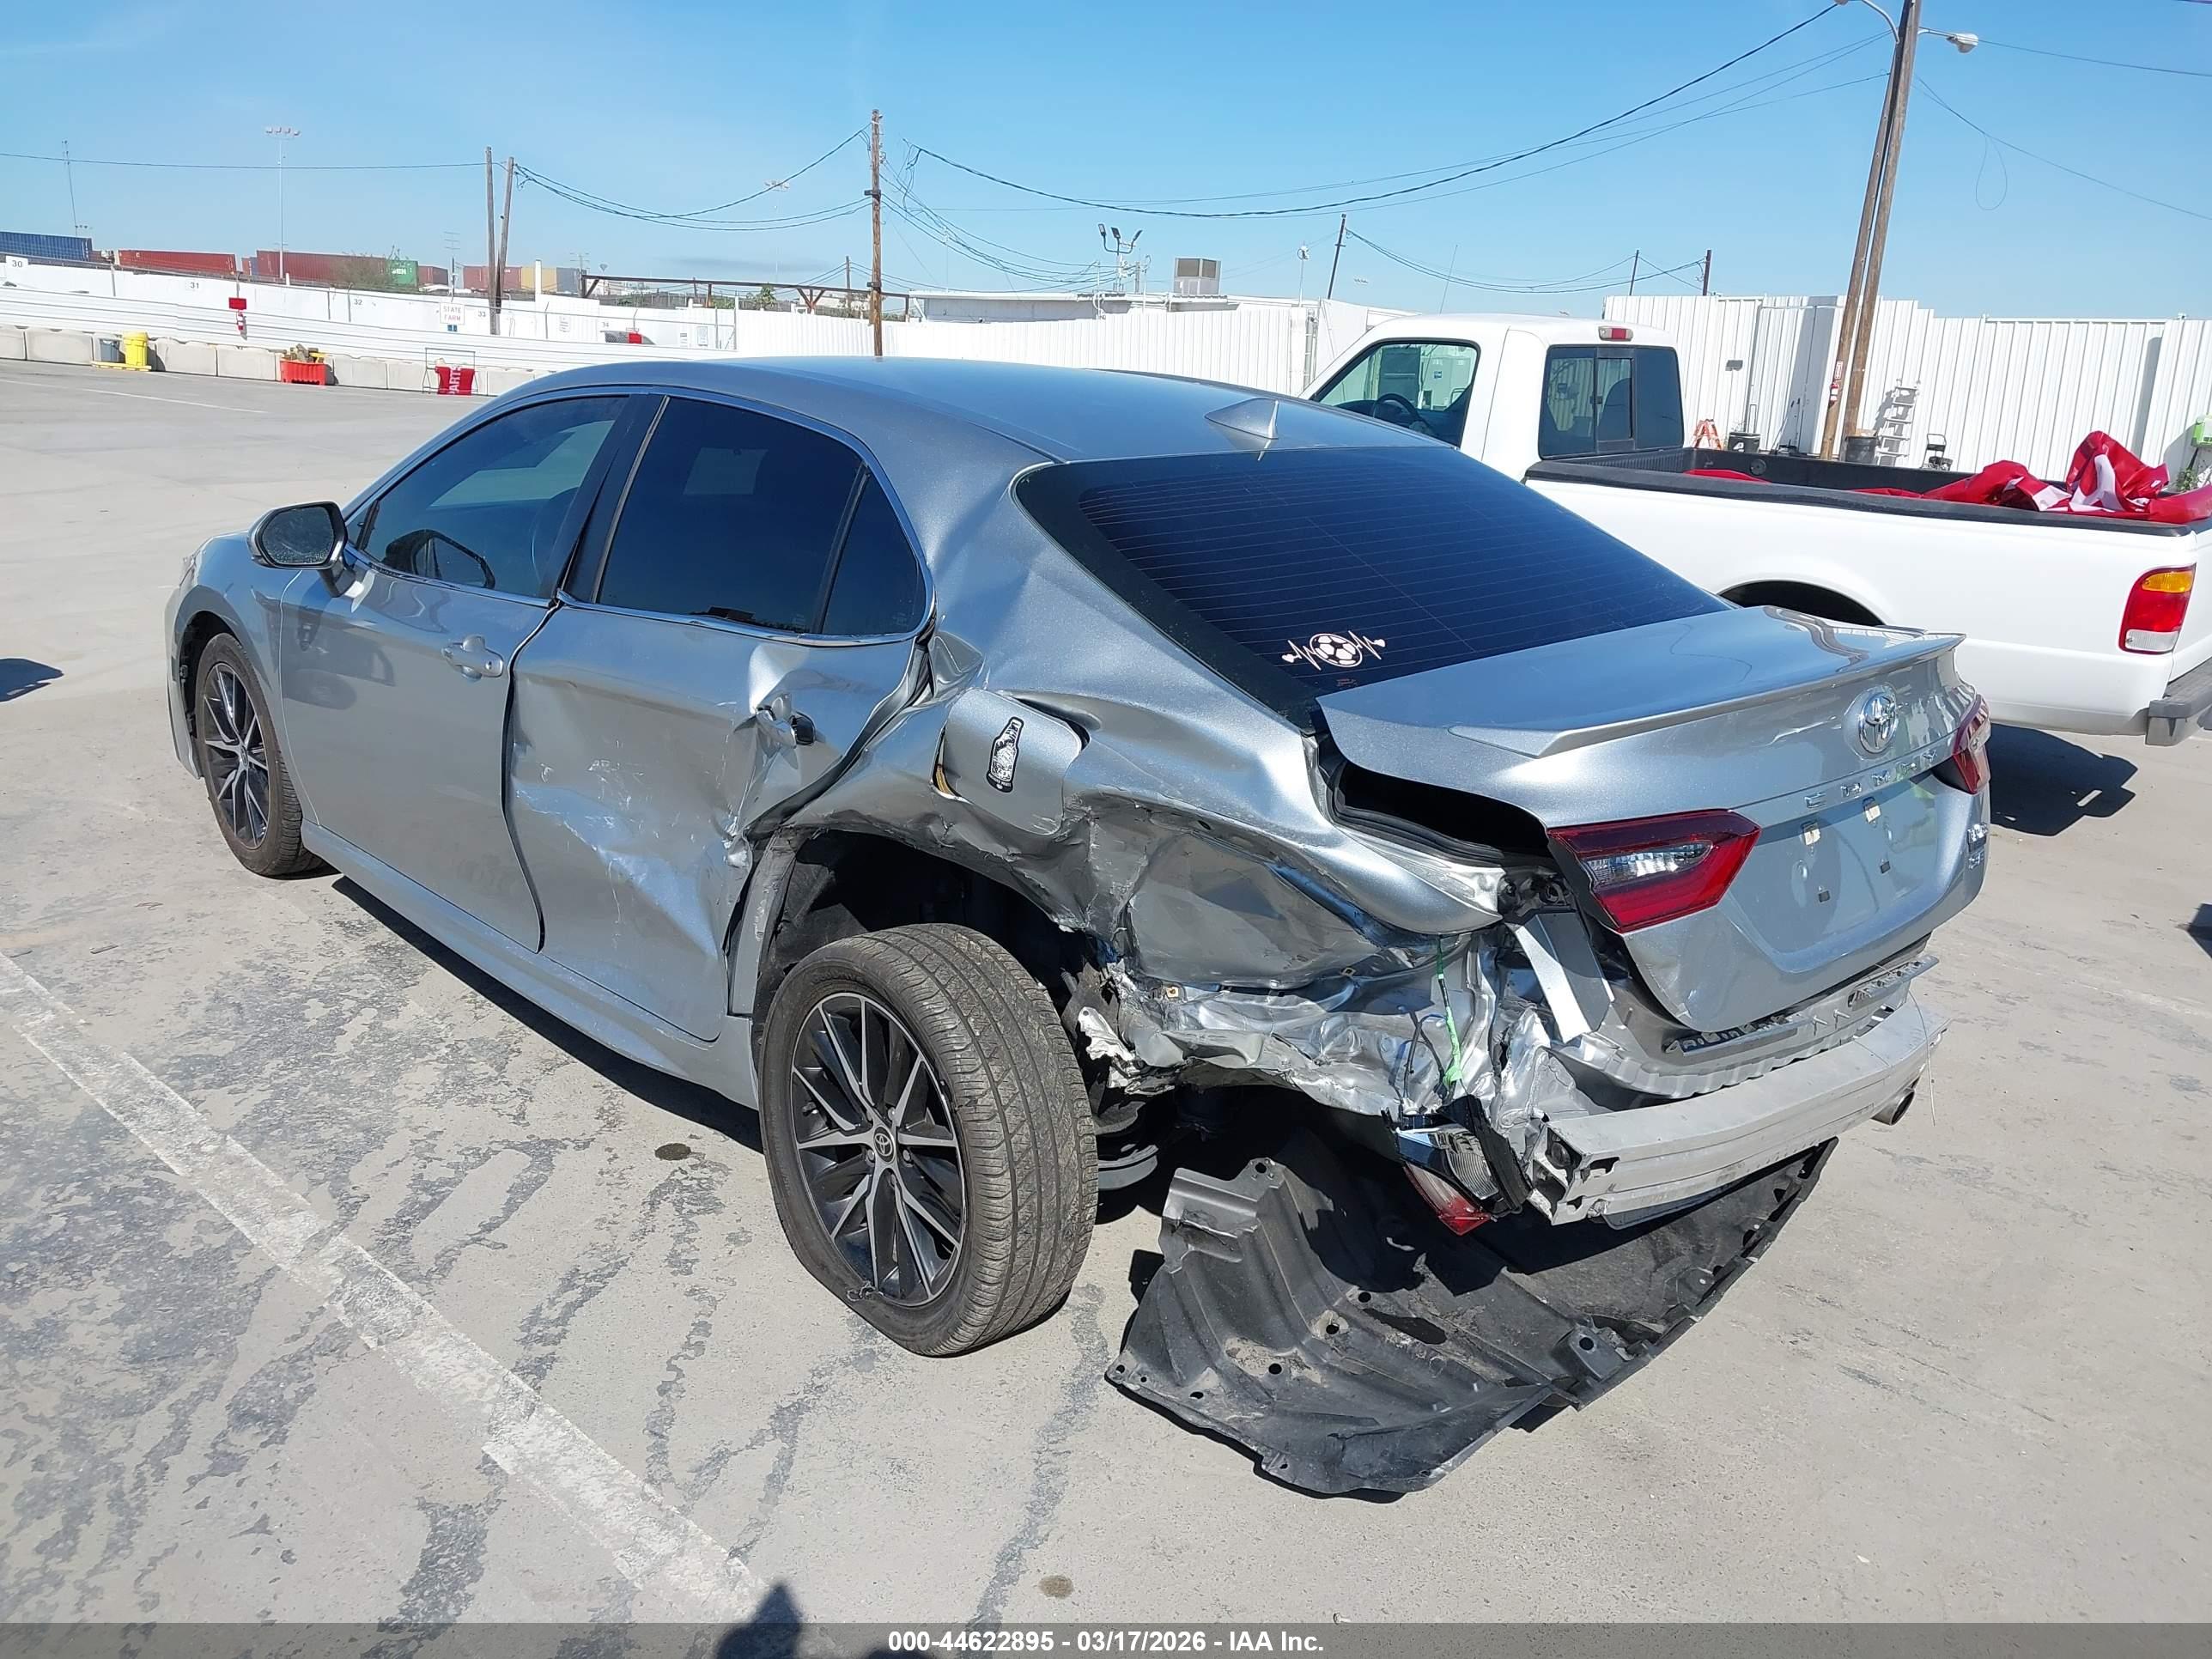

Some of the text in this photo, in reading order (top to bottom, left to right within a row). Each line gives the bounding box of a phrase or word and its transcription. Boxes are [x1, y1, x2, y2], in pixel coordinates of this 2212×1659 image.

[11, 259, 23, 268] 30
[443, 305, 462, 314] STATE
[1804, 749, 1938, 808] CAMRY
